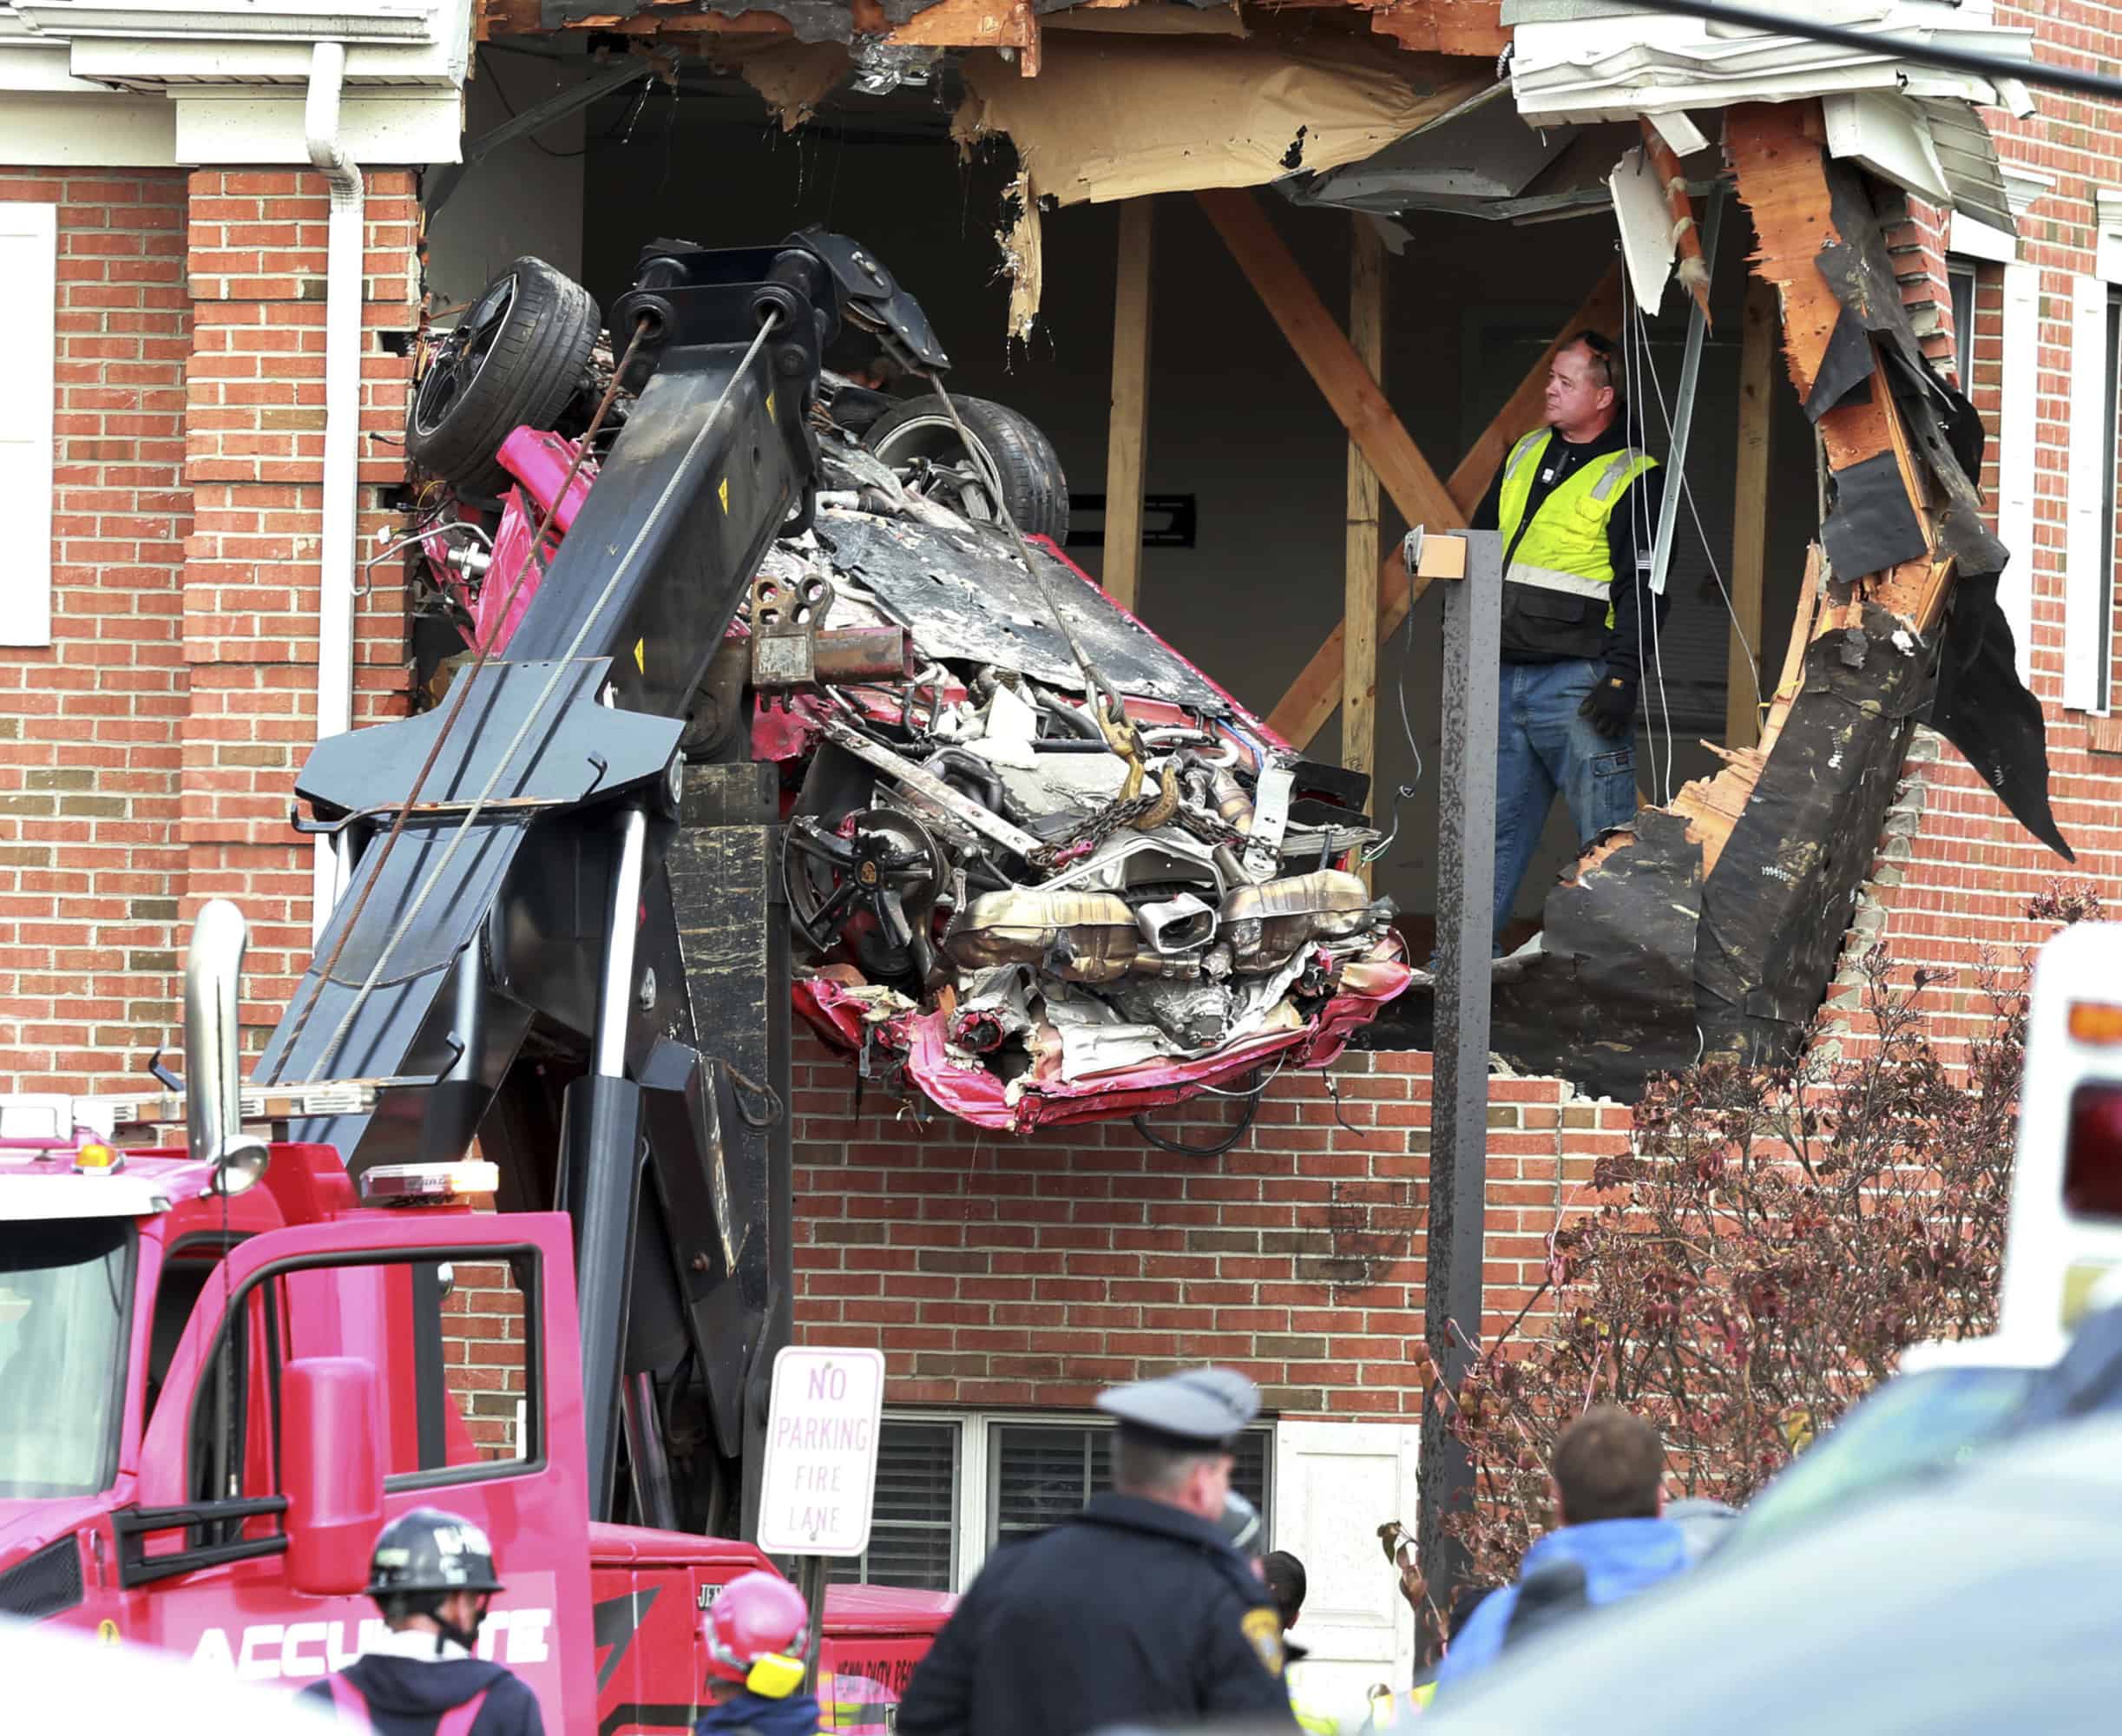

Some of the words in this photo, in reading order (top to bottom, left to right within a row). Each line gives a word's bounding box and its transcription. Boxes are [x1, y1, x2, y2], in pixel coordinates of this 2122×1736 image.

[807, 1367, 847, 1401] NO
[777, 1416, 869, 1452] PARKING
[794, 1464, 842, 1492] FIRE
[787, 1506, 841, 1534] LANE
[189, 1608, 552, 1679] ACCUTE
